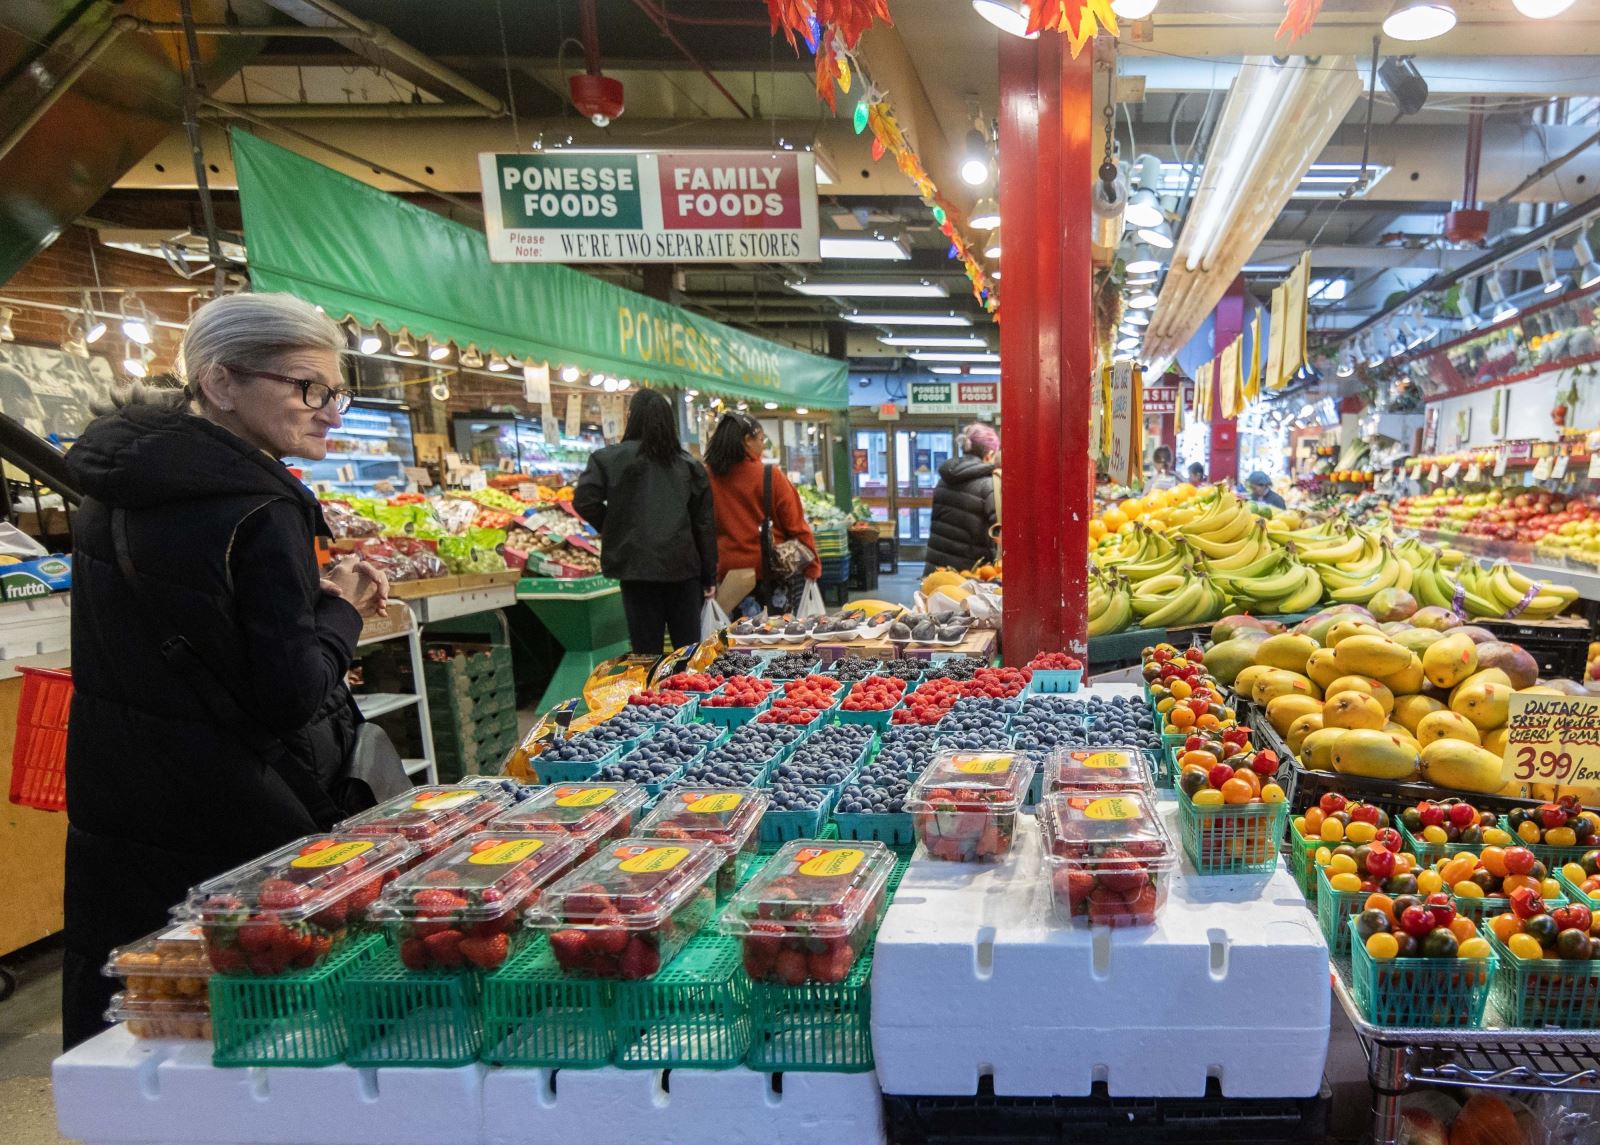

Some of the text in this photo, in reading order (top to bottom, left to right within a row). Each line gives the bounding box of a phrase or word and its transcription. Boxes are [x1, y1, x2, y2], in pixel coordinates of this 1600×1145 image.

[503, 166, 634, 192] PONESSE
[674, 167, 782, 191] FAMILY
[523, 193, 618, 218] FOODS
[678, 193, 784, 217] FOODS
[510, 233, 545, 246] Please
[560, 233, 800, 258] WE'RE TWO SEPARATE STORES
[515, 245, 543, 257] Note:
[618, 305, 782, 389] PONESSE FOODS
[913, 386, 950, 394] PONESSE
[961, 386, 993, 394] FAMILY
[1143, 390, 1194, 401] ASHIR
[918, 394, 946, 402] FOODS
[7, 583, 45, 598] frutta
[1524, 700, 1598, 716] ONTARIO
[1511, 714, 1552, 727] FRESH
[1509, 729, 1554, 741] CHERRY
[1514, 746, 1573, 780] 3.99
